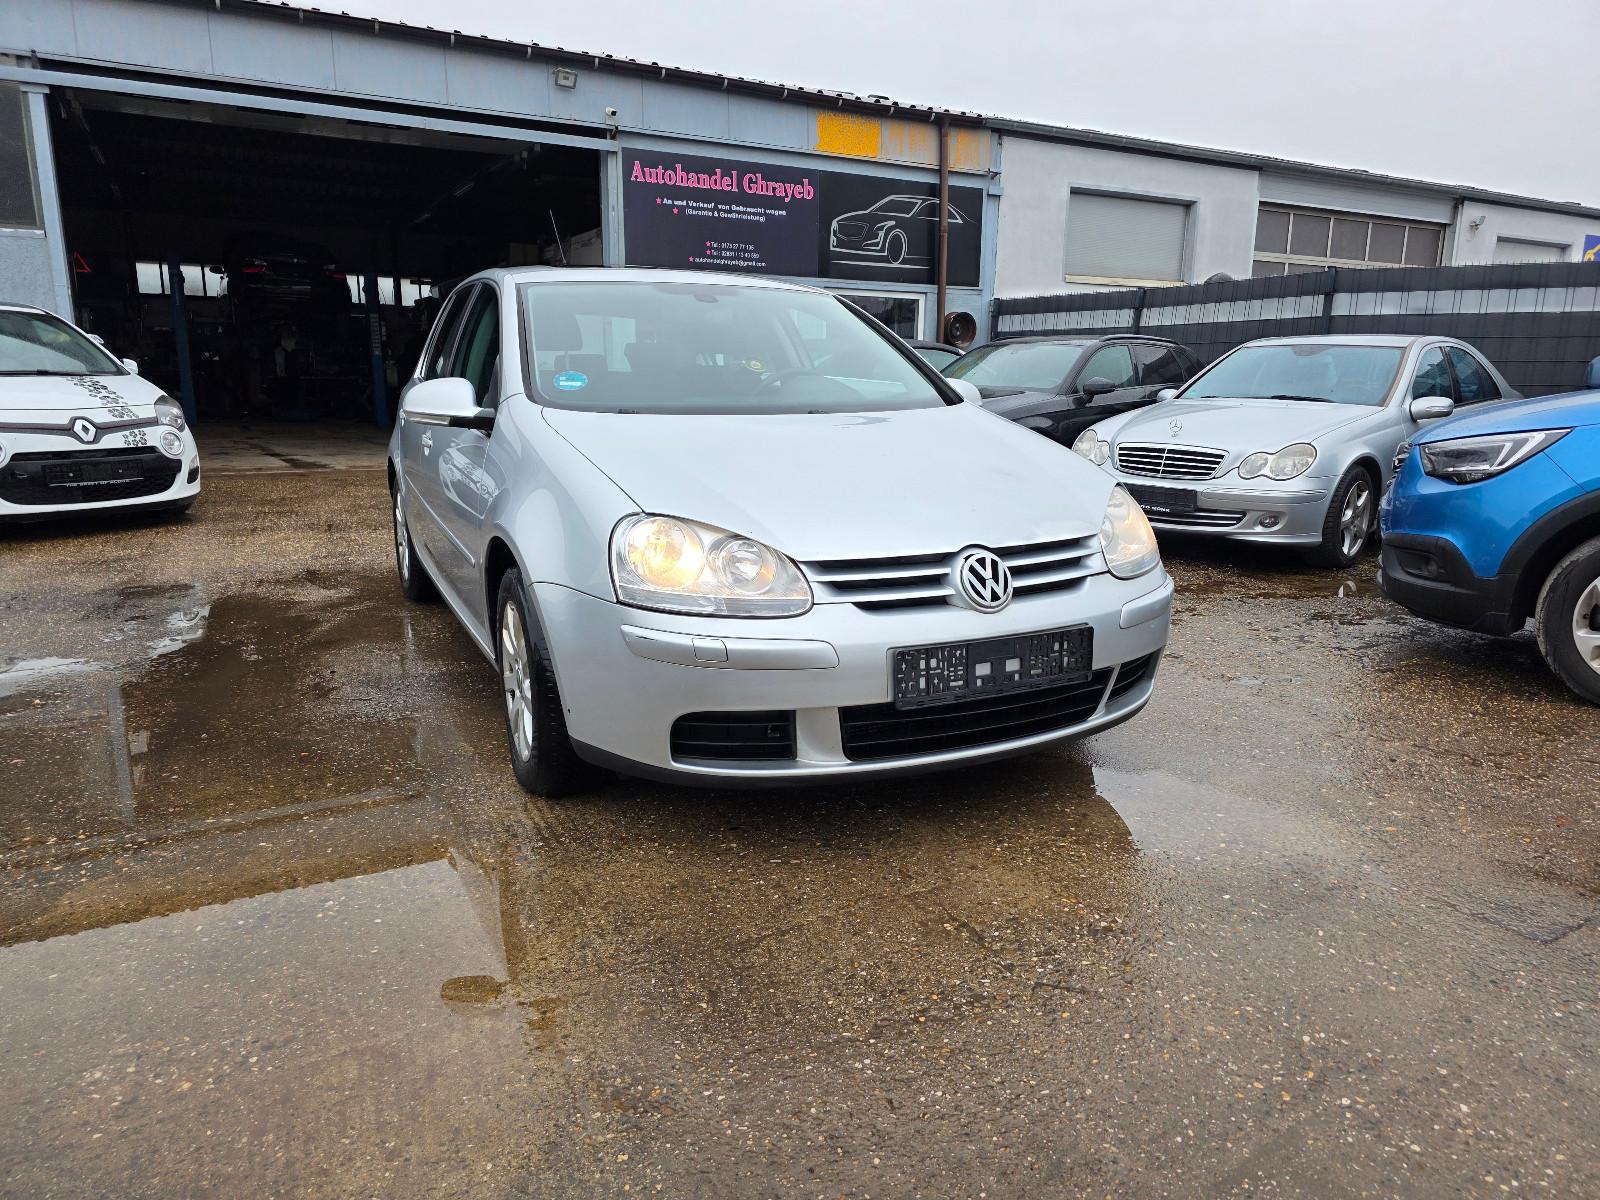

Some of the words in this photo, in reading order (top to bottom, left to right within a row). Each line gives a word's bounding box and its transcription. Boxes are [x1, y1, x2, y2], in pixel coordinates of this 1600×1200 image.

[630, 160, 738, 192] Autohandel
[743, 172, 815, 203] Ghrayeb
[662, 197, 672, 205] An
[688, 200, 715, 209] Verkauf
[731, 205, 765, 214] Gebraucht
